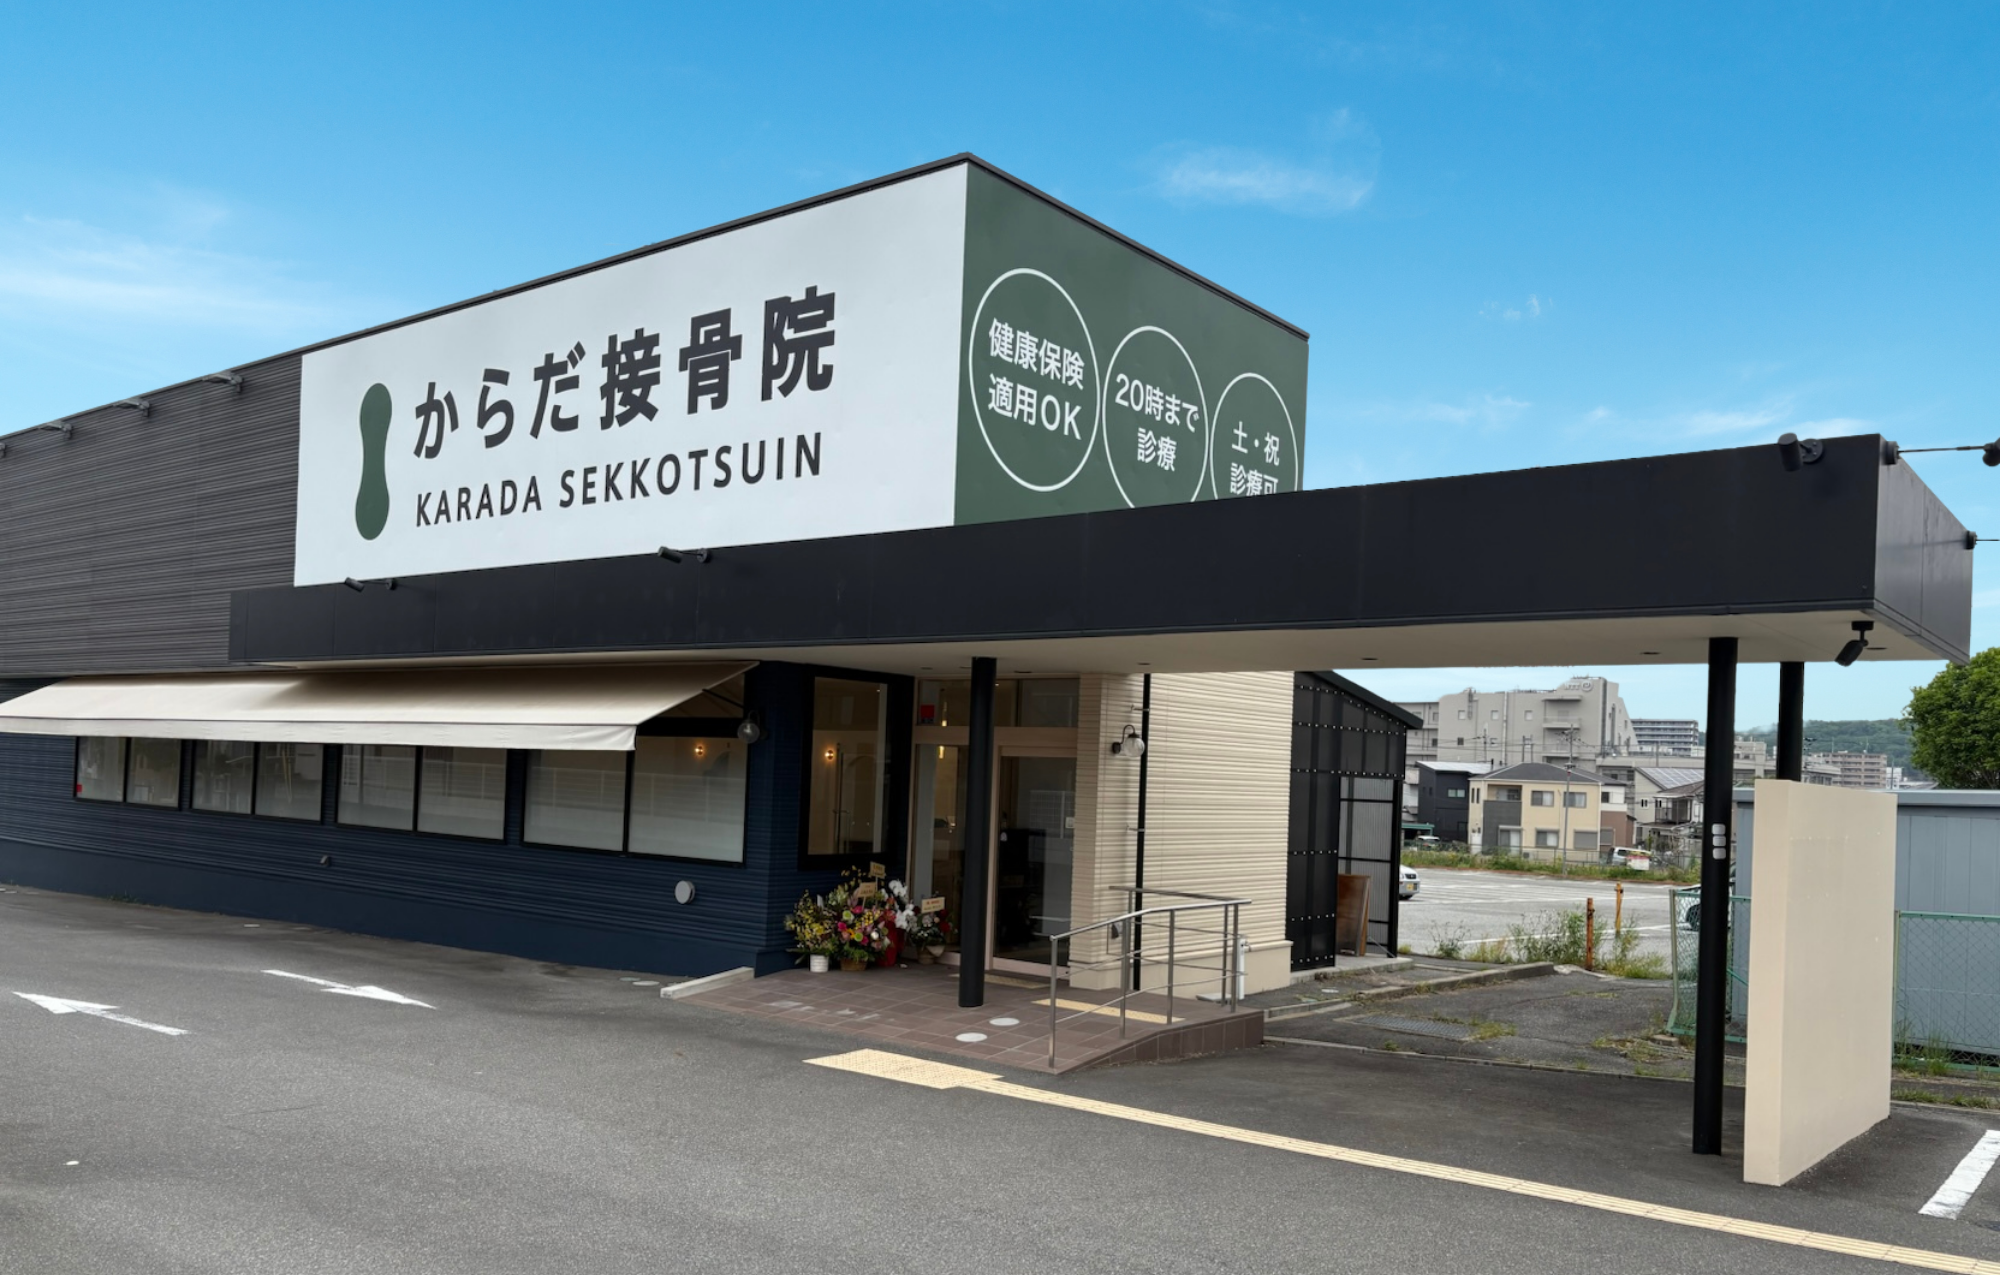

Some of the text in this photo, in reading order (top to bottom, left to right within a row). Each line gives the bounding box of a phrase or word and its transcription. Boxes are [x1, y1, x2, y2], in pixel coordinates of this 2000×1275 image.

[413, 285, 836, 459] からだ接骨院
[988, 317, 1085, 390] 健康保険
[987, 373, 1082, 440] 適用OK
[1114, 373, 1200, 432] 20時まで
[1136, 427, 1177, 472] 診療
[1231, 420, 1280, 467] 土・祝
[416, 432, 822, 527] KARADA SEKKOTSUIN
